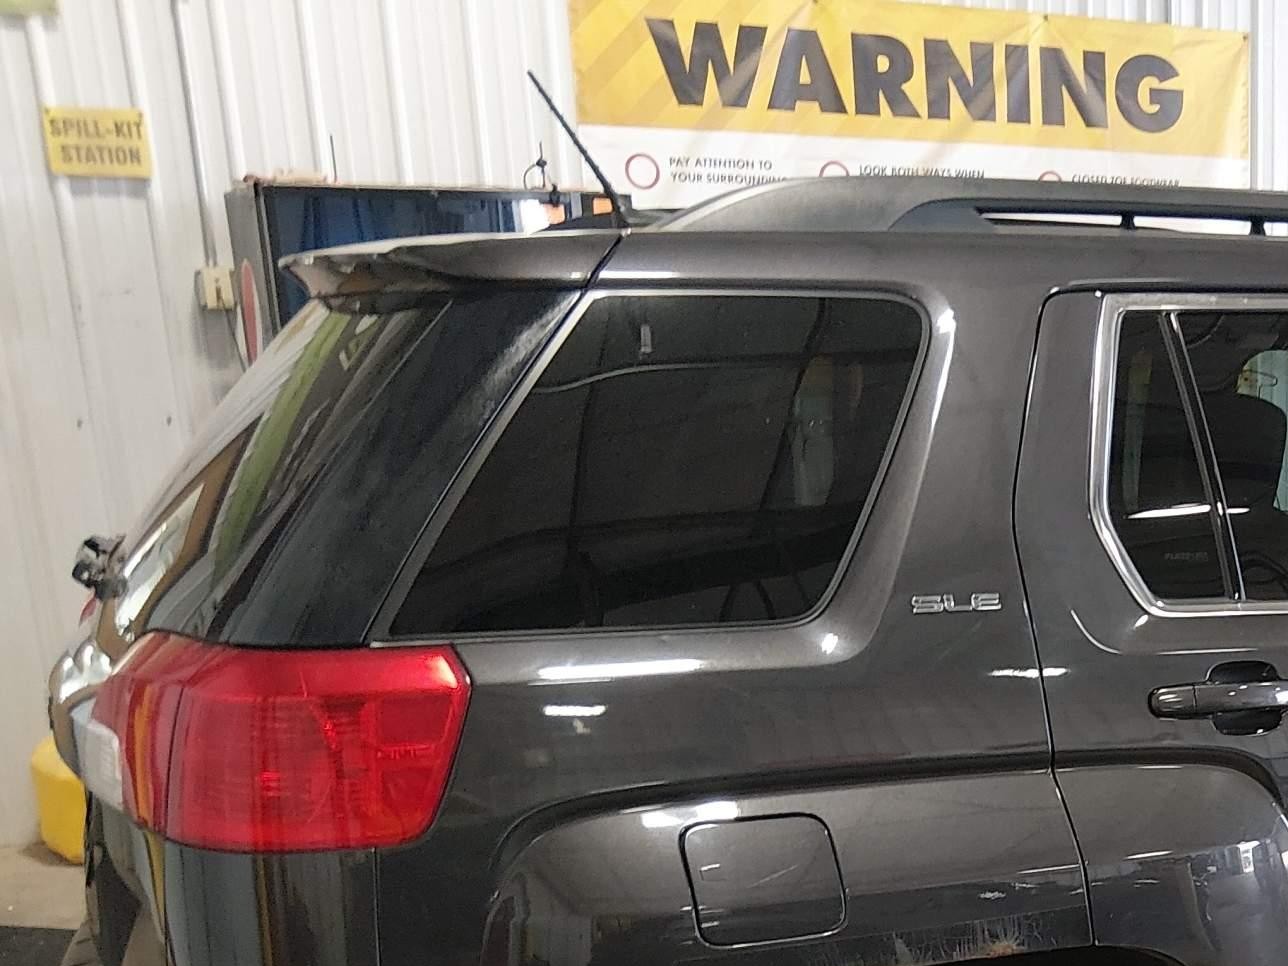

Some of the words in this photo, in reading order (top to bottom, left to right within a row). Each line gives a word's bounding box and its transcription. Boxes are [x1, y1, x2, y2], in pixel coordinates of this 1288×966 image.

[644, 17, 1184, 134] WARNING
[49, 118, 142, 139] SPILL-KIT
[61, 145, 142, 165] STATION
[669, 156, 690, 168] PAY
[695, 158, 755, 170] ATTENTION
[759, 159, 773, 171] TO
[671, 172, 703, 184] YOUR
[859, 164, 887, 176] LOOK
[911, 593, 1002, 614] SLE
